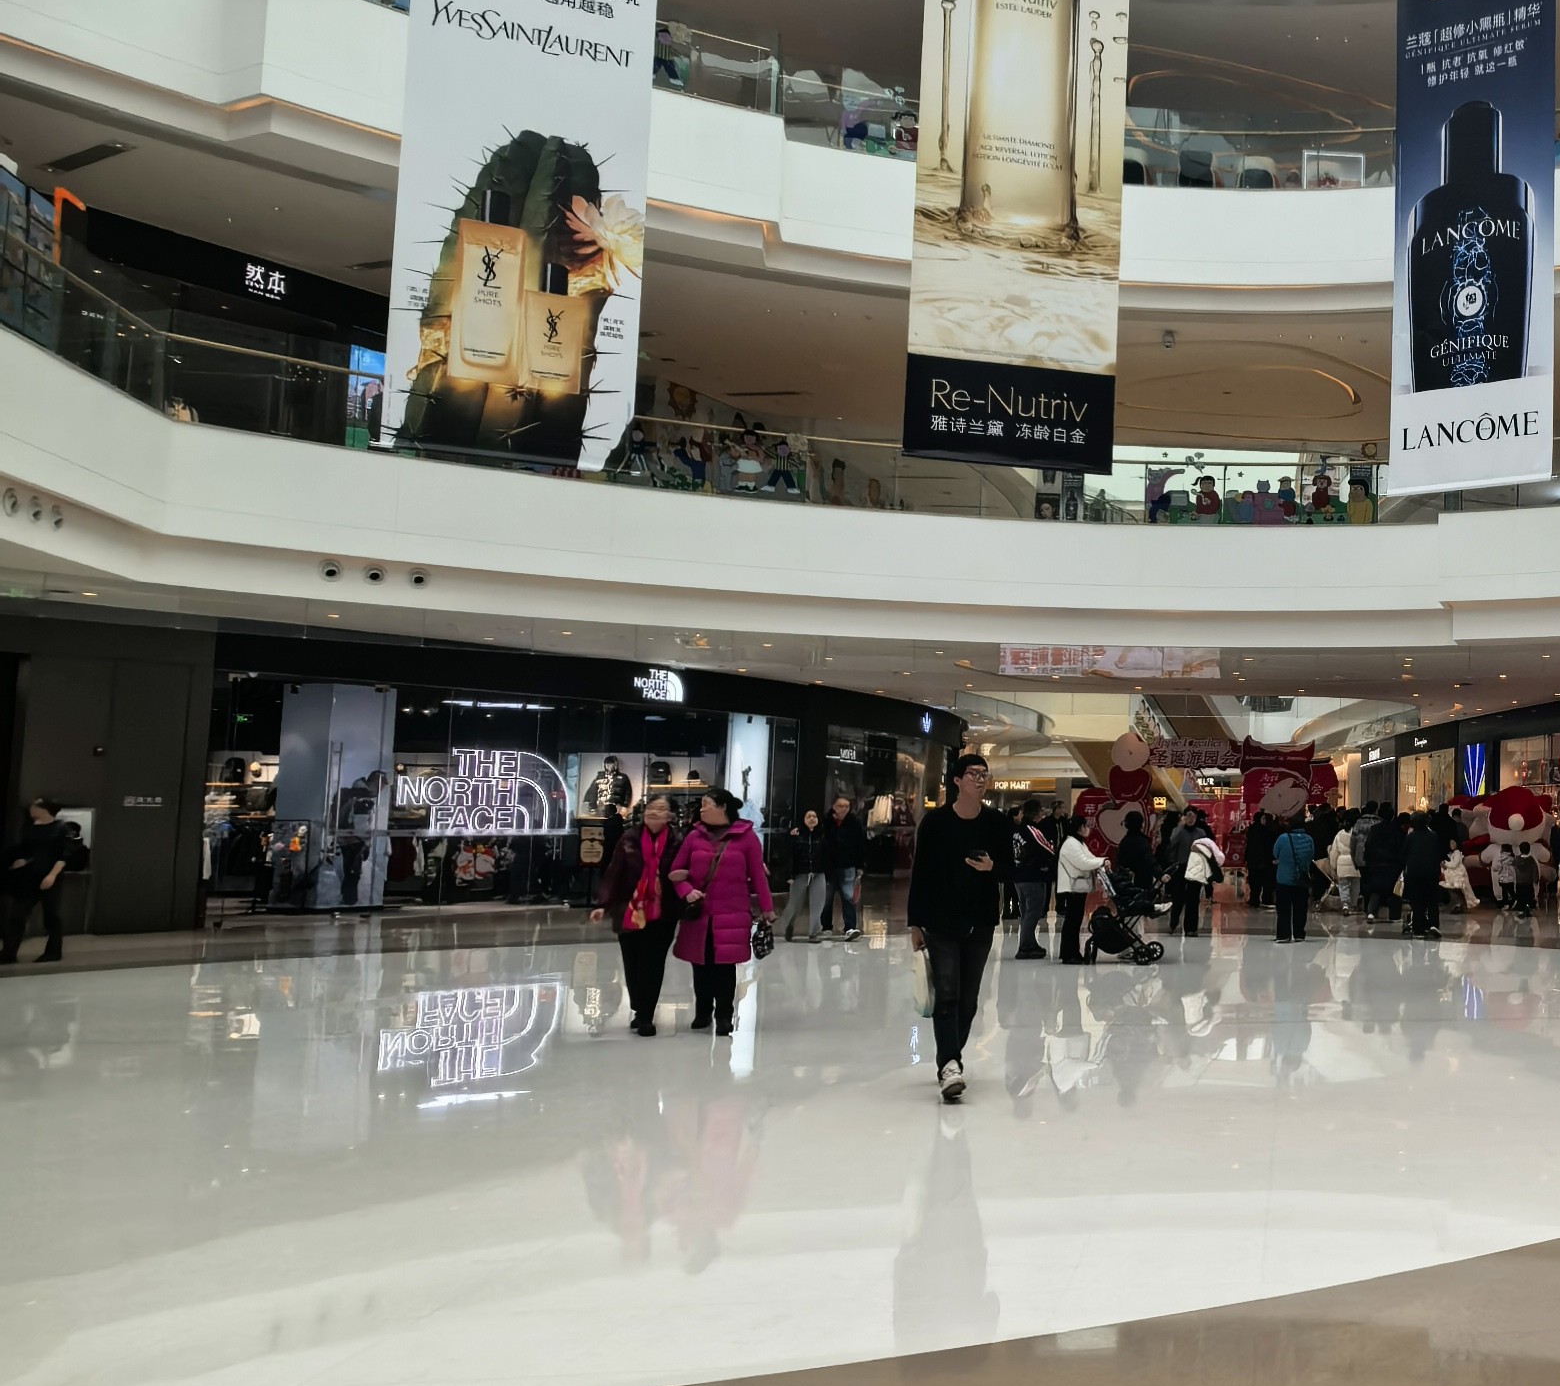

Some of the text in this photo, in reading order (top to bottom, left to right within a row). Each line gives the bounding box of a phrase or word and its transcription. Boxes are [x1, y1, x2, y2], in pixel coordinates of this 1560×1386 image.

[1421, 215, 1521, 256] LANCÔME
[1430, 333, 1509, 358] GÉNIFIQUE
[930, 378, 1088, 423] Re-Nutriv
[930, 414, 1085, 445] 雅诗兰黛 冻龄白金
[1402, 410, 1539, 451] LANCÔME
[633, 676, 667, 690] NORTH
[649, 668, 668, 680] THE
[642, 687, 667, 700] FACE
[452, 747, 518, 779] THE
[1149, 748, 1241, 769] 圣诞游园会
[396, 774, 518, 807] NORTH
[994, 780, 1030, 790] POP MART
[429, 805, 517, 832] FACE
